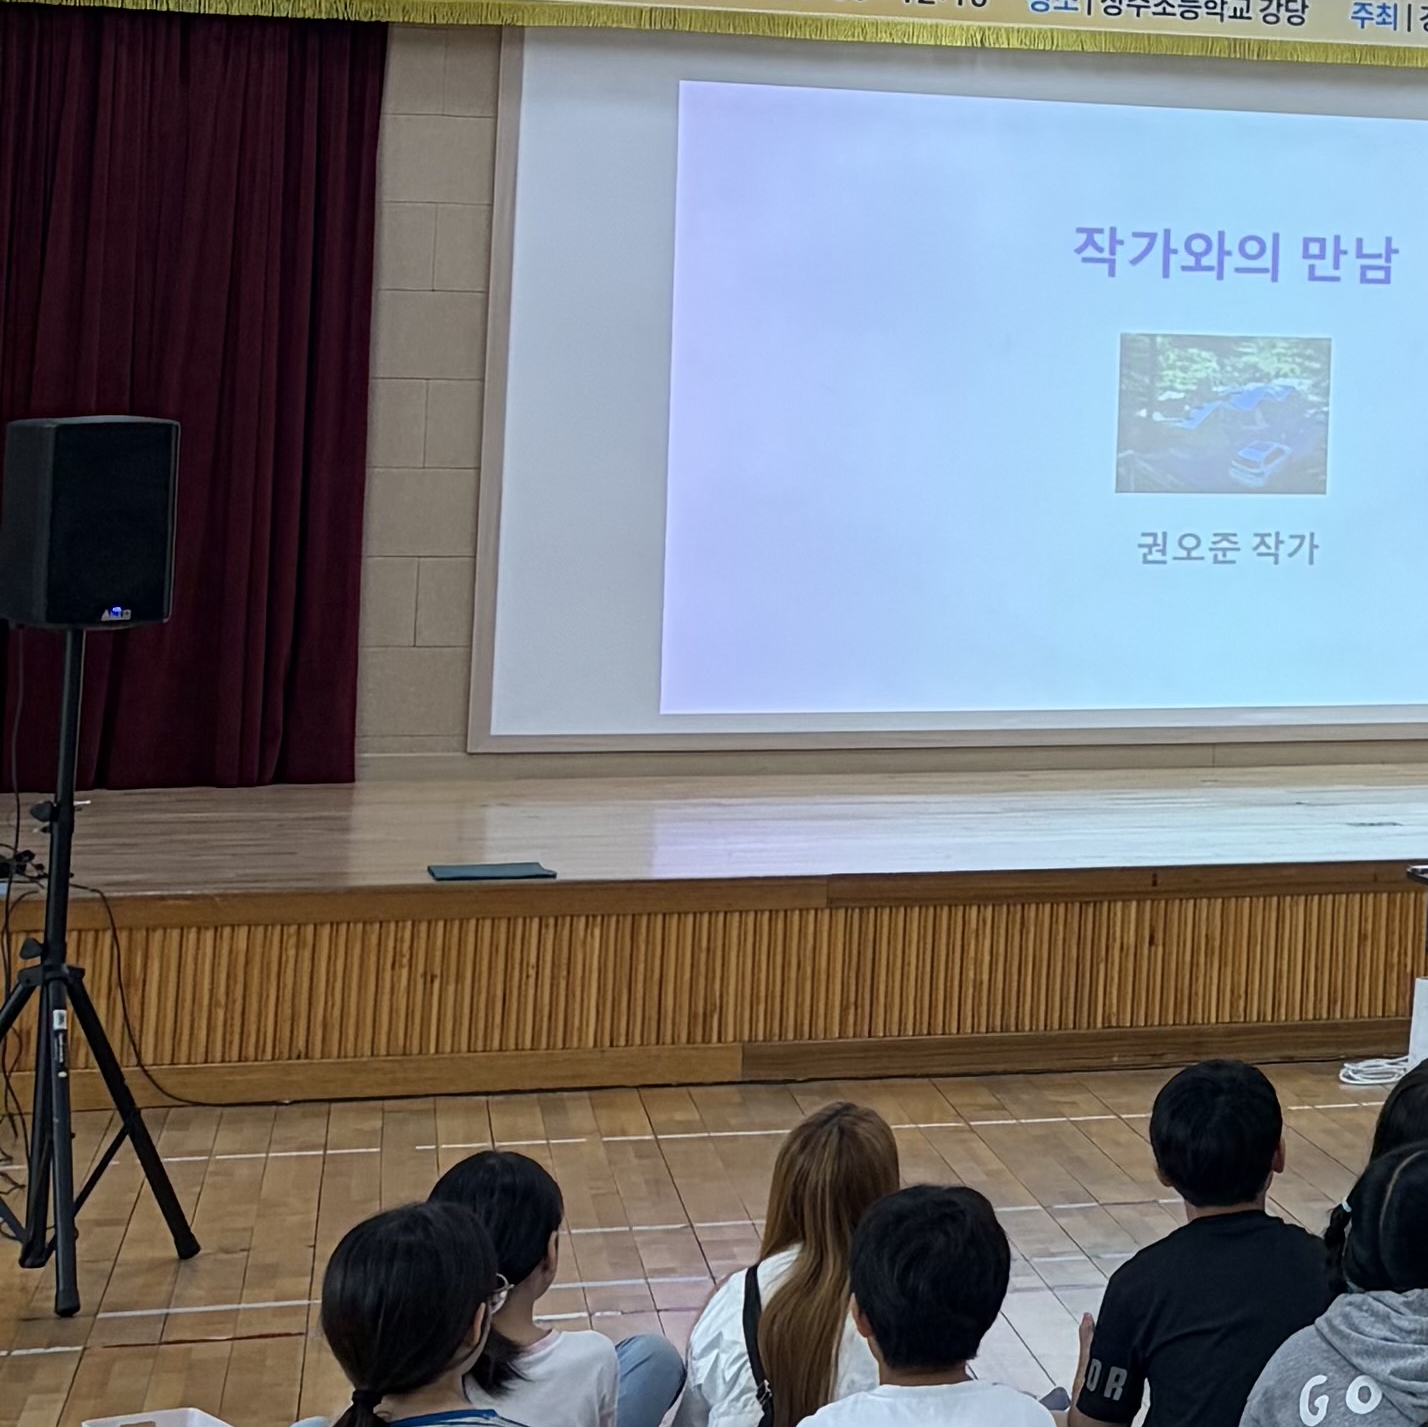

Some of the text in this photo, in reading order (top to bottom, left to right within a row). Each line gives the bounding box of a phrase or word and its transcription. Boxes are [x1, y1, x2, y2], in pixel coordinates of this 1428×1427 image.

[1350, 0, 1399, 33] 주최
[1073, 226, 1400, 285] 작가와의 만남
[1137, 531, 1320, 565] 권오준 작가
[1299, 1374, 1383, 1427] GO
